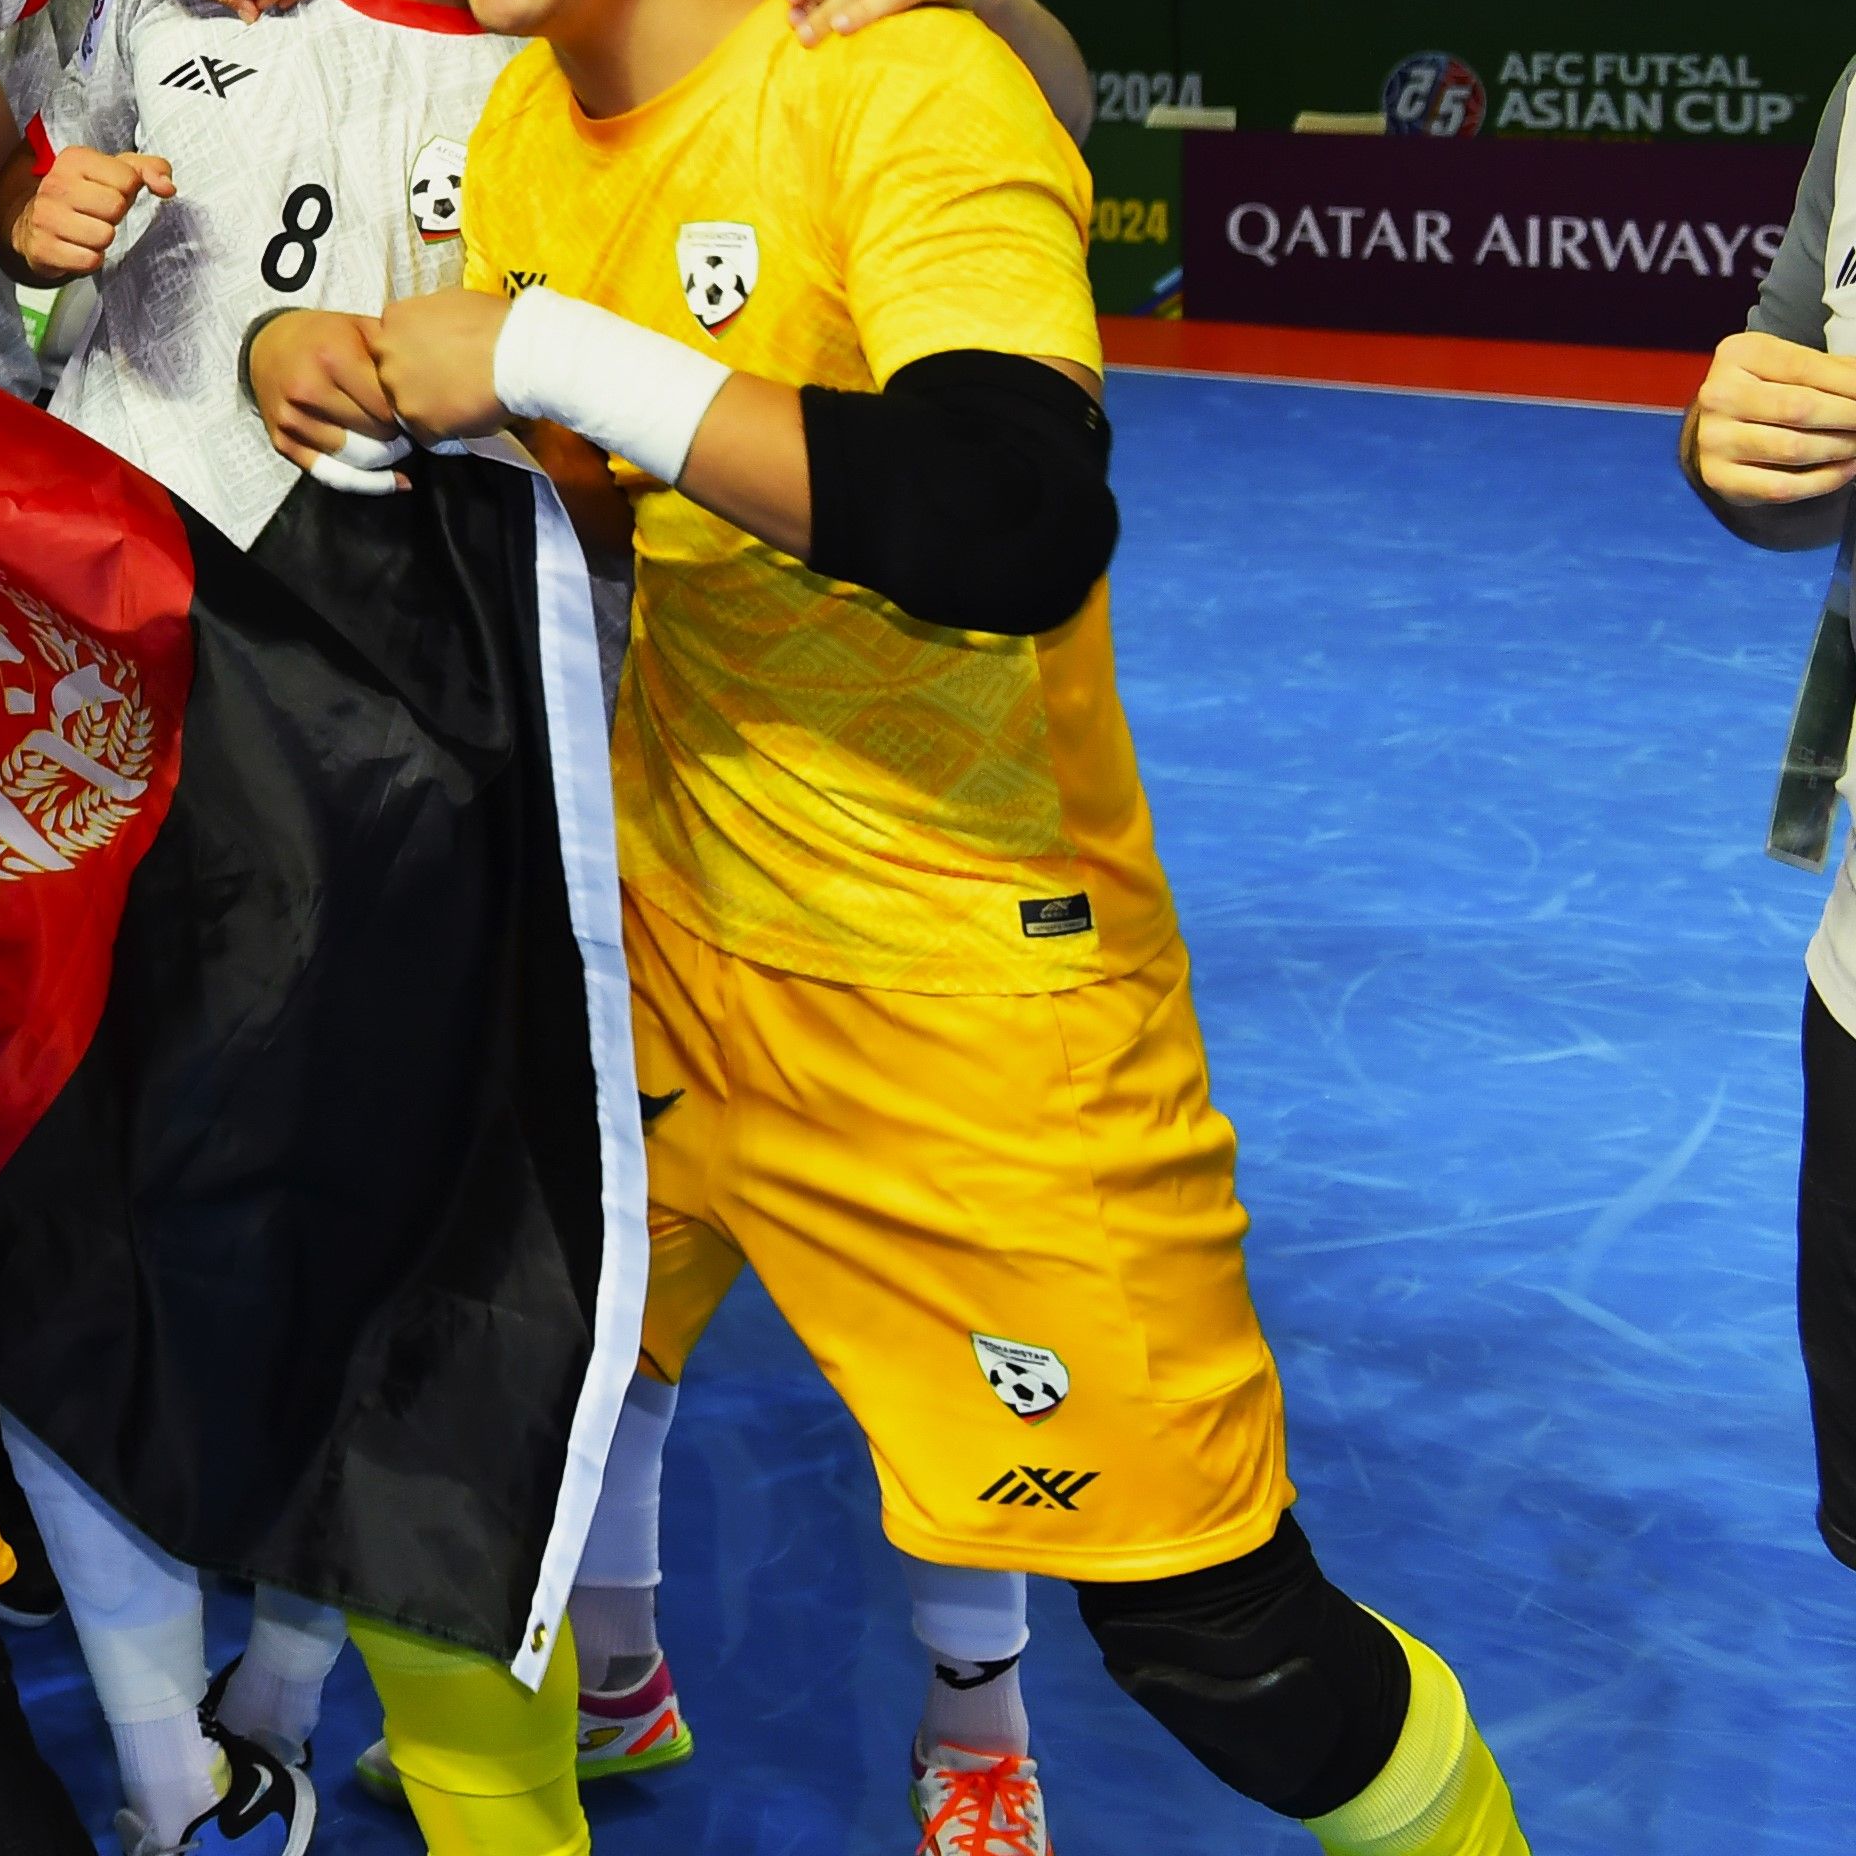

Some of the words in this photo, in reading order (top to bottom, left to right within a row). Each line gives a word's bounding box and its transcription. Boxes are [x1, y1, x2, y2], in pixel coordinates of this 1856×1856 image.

[1499, 51, 1585, 86] AFC
[1595, 52, 1761, 88] FUTSAL
[1495, 88, 1664, 133] ASIAN
[1675, 92, 1795, 135] CUP
[261, 183, 332, 293] 8
[1225, 202, 1454, 268] QATAR
[1475, 214, 1788, 282] AIRWAYS
